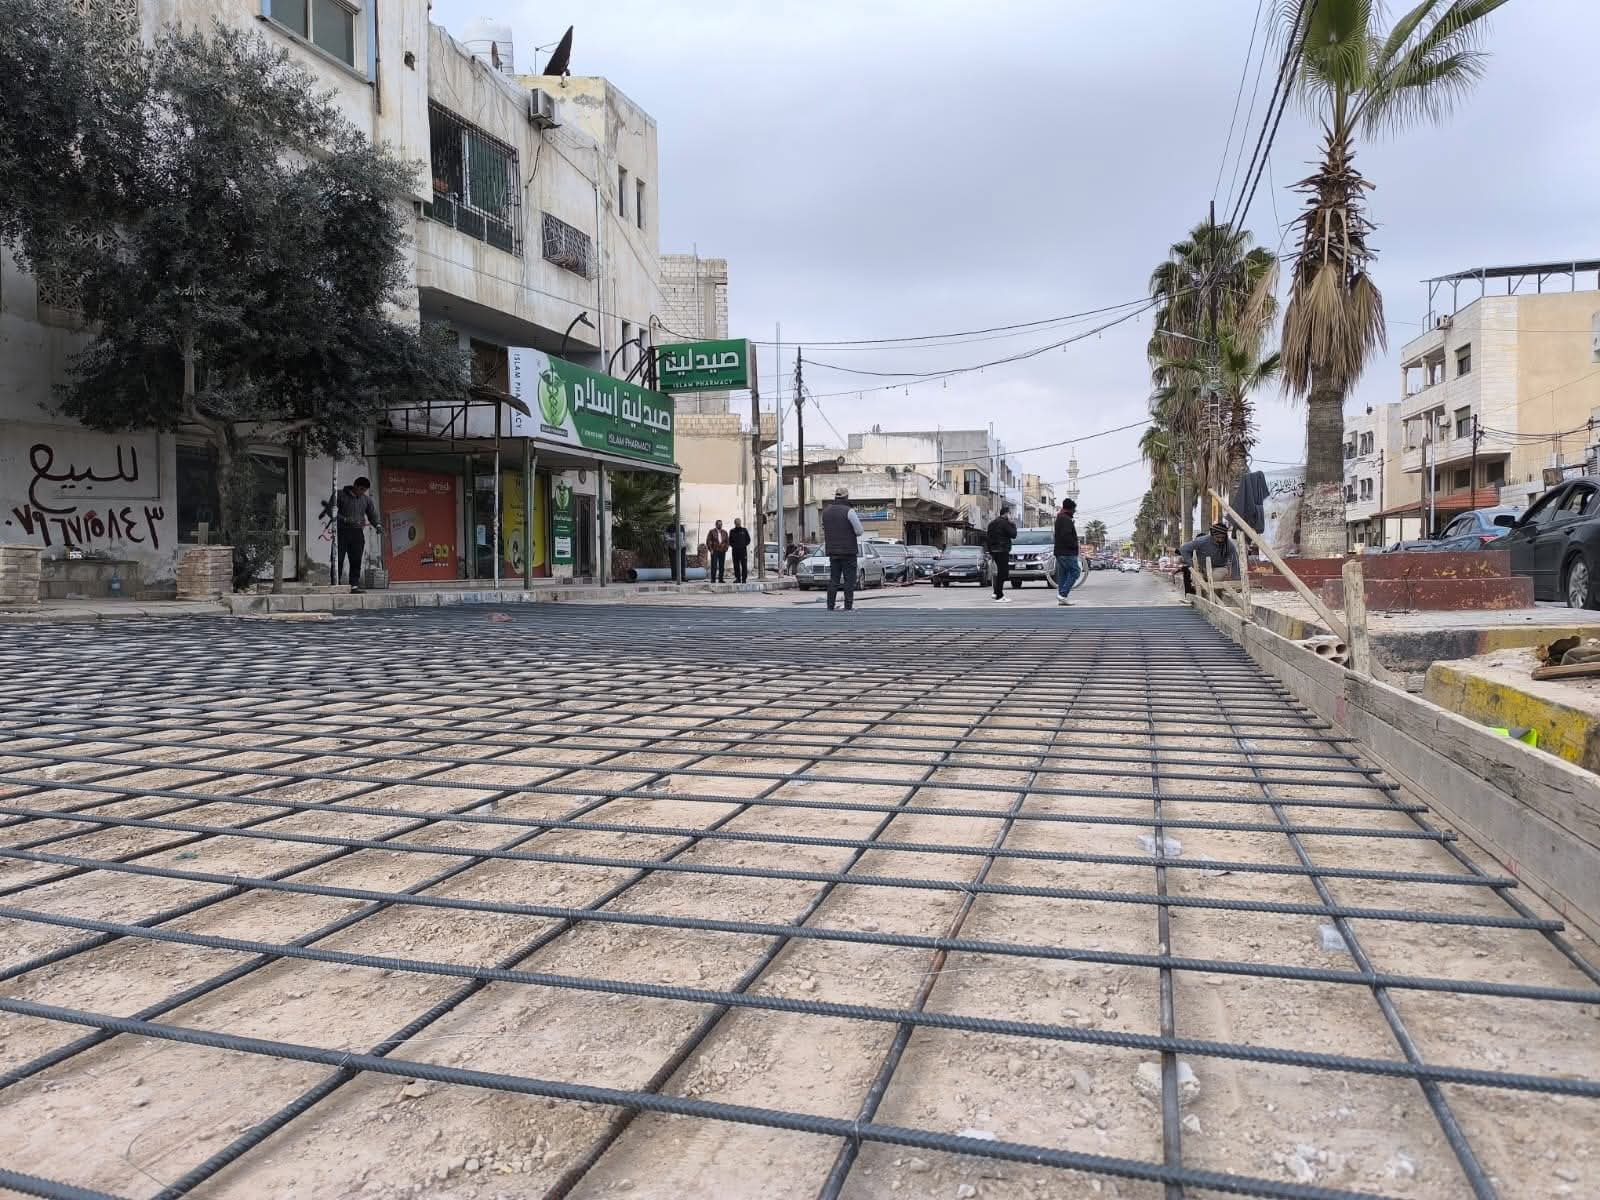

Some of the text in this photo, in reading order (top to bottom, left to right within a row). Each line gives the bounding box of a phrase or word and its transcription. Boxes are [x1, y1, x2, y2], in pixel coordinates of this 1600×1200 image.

[666, 348, 739, 375] صيدلية
[695, 378, 732, 387] PHARMACY
[513, 353, 522, 429] ISLAM PHAACY
[574, 376, 671, 433] صيدلية إسلام
[608, 432, 625, 446] ISLAM
[624, 437, 651, 452] PHARMACY
[29, 443, 138, 514] للبيع
